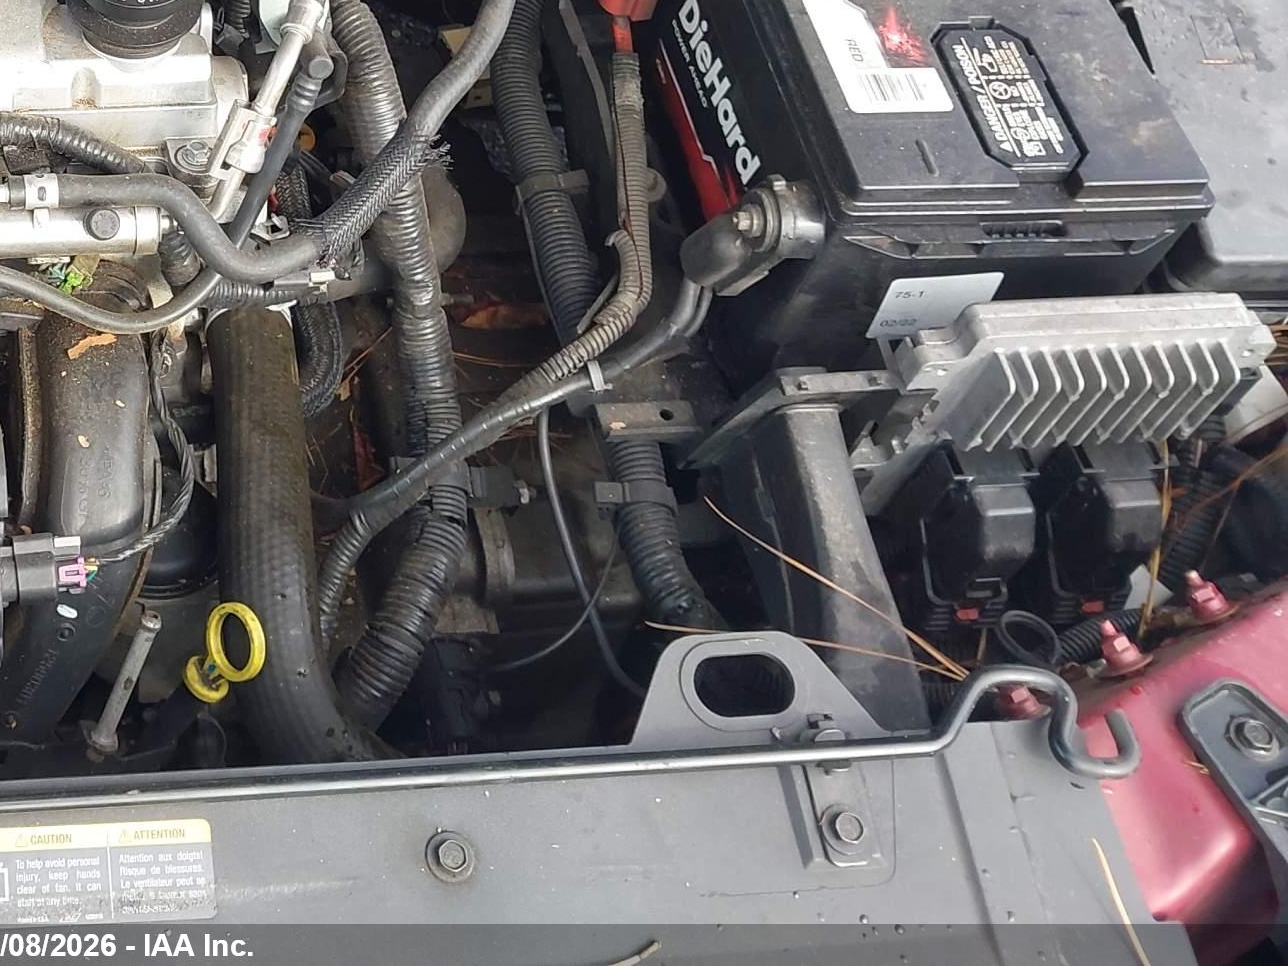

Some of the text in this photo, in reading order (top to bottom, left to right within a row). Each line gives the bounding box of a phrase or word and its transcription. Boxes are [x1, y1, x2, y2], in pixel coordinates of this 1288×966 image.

[845, 38, 865, 63] RED
[952, 44, 982, 85] POISON
[976, 94, 1009, 141] DANGER
[895, 290, 925, 299] 75-1
[30, 834, 72, 846] CAUTION
[134, 828, 185, 840] ATTENTION
[15, 856, 100, 870] To help avoid personal
[119, 853, 154, 864] Attention
[158, 853, 172, 862] aux
[16, 869, 101, 884] injury, keep hands
[119, 866, 146, 877] Risque
[150, 866, 161, 874] de
[16, 885, 37, 895] clear
[41, 884, 50, 894] of
[86, 883, 102, 891] can
[120, 879, 131, 889] Le
[176, 877, 194, 887] peut
[196, 877, 206, 885] se
